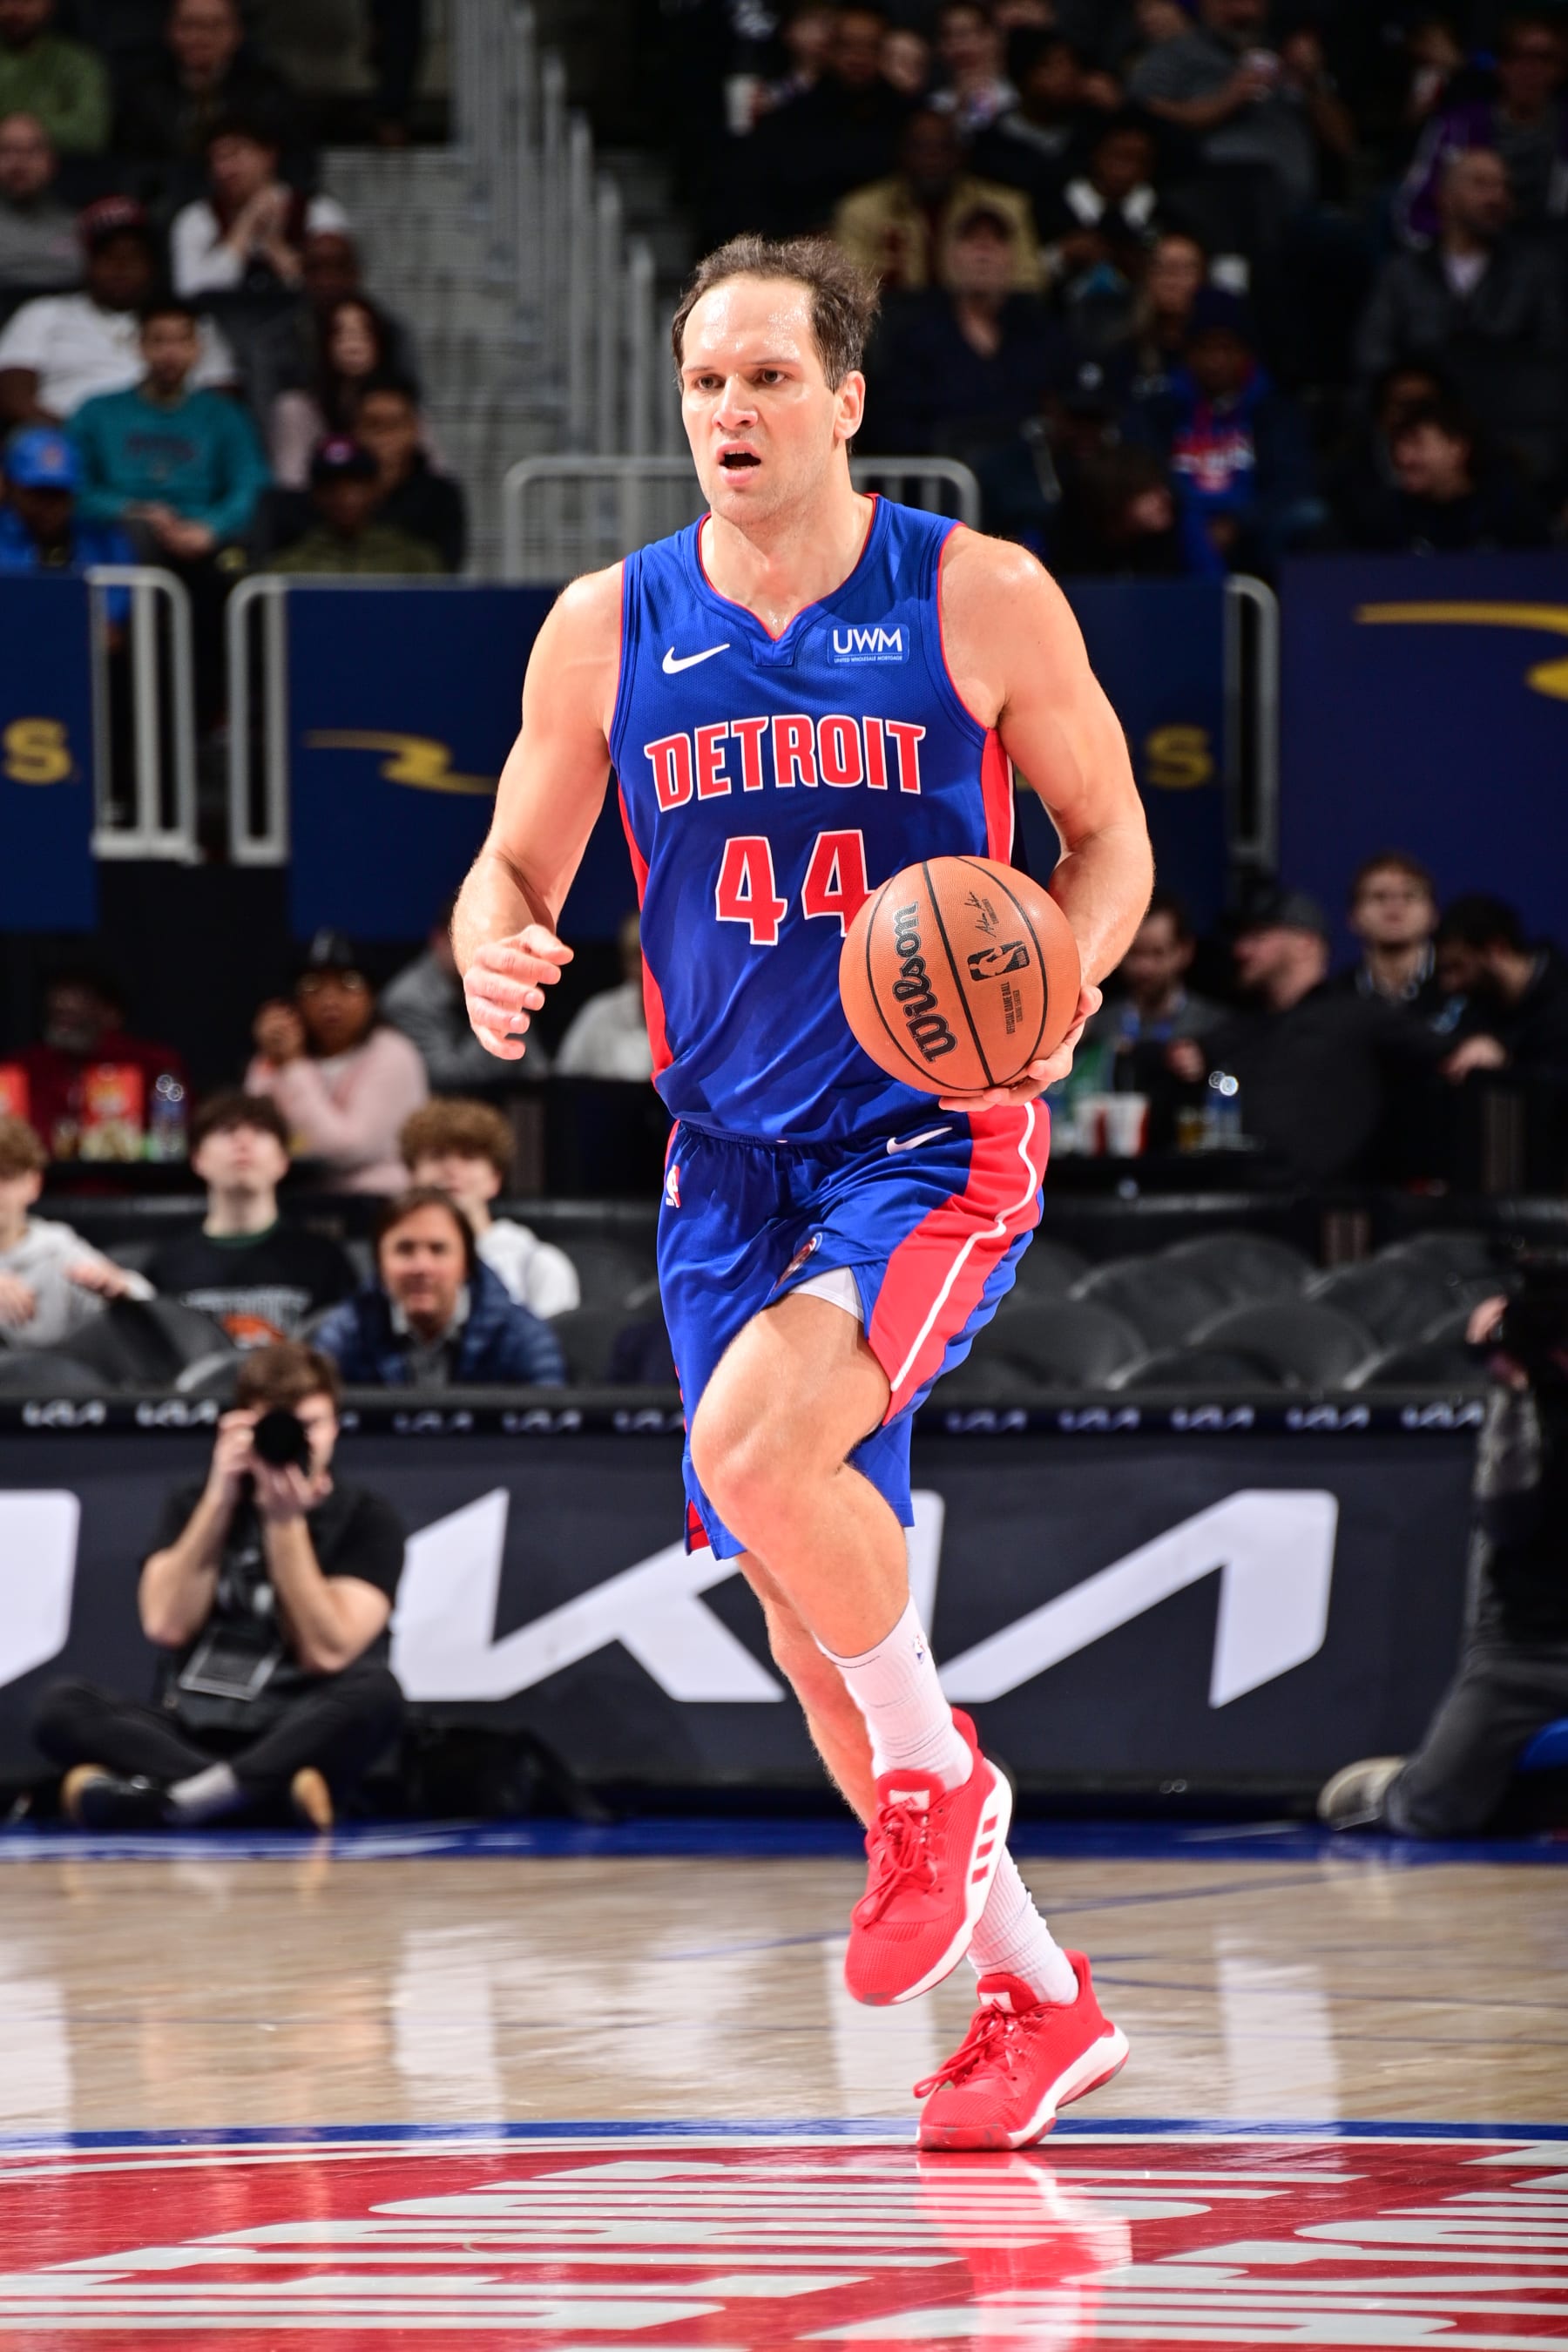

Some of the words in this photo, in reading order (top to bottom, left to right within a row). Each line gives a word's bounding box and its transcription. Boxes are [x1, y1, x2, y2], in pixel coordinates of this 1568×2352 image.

[833, 627, 902, 654] UWM
[644, 714, 926, 812] DETROIT
[715, 829, 874, 946] 44
[892, 902, 957, 1063] Wilson
[1001, 981, 1011, 997] BALL
[1003, 996, 1014, 1011] GAME
[391, 1486, 1339, 1708] KA
